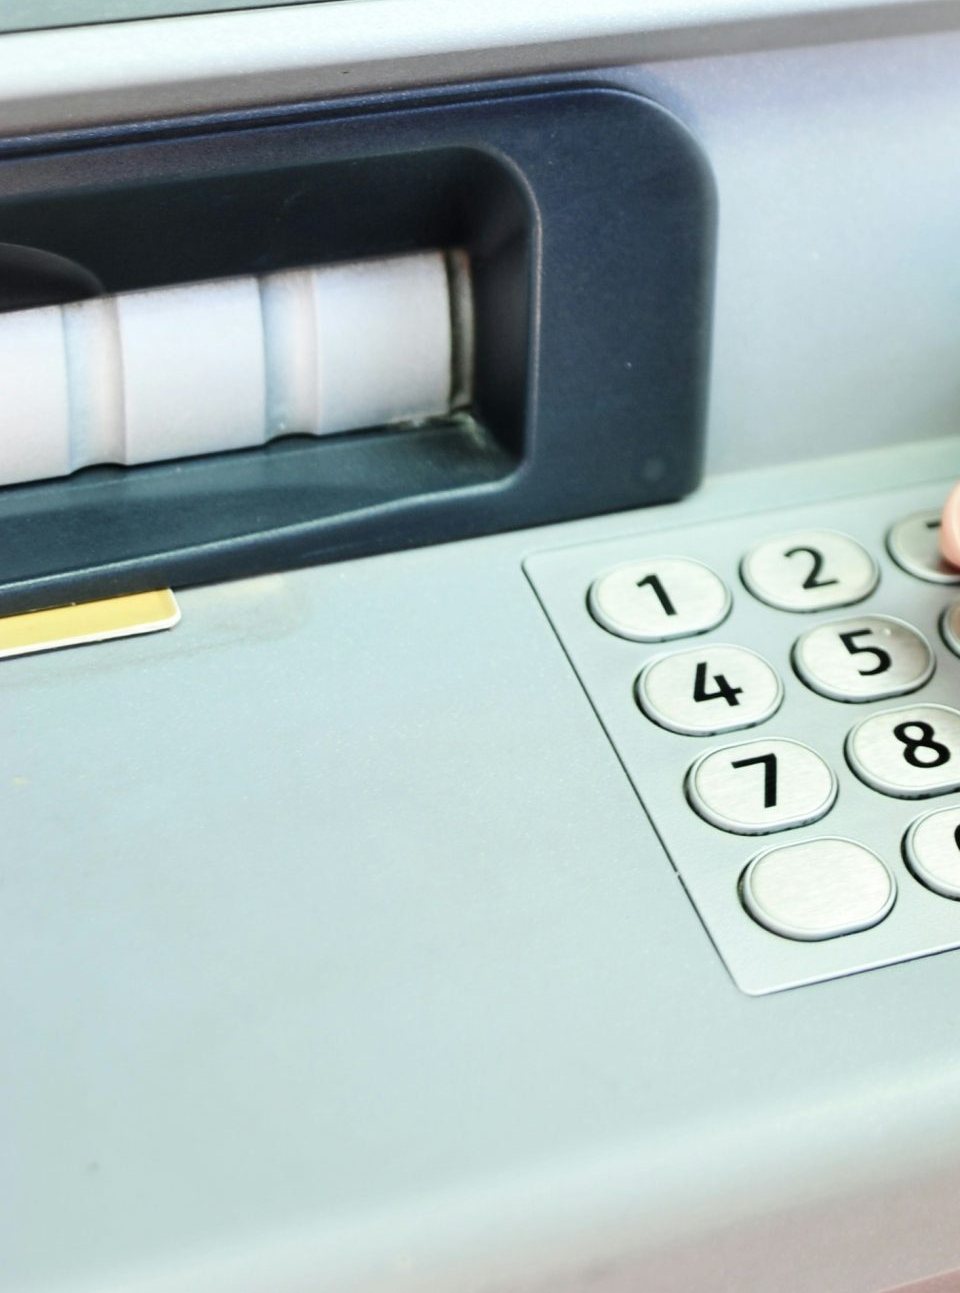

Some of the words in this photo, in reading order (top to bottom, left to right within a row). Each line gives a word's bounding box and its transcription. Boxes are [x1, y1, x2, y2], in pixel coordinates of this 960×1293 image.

[783, 546, 839, 590] 2
[636, 574, 677, 616] 1
[838, 628, 892, 677] 5
[692, 661, 743, 707] 4
[893, 720, 951, 769] 8
[731, 752, 778, 809] 7
